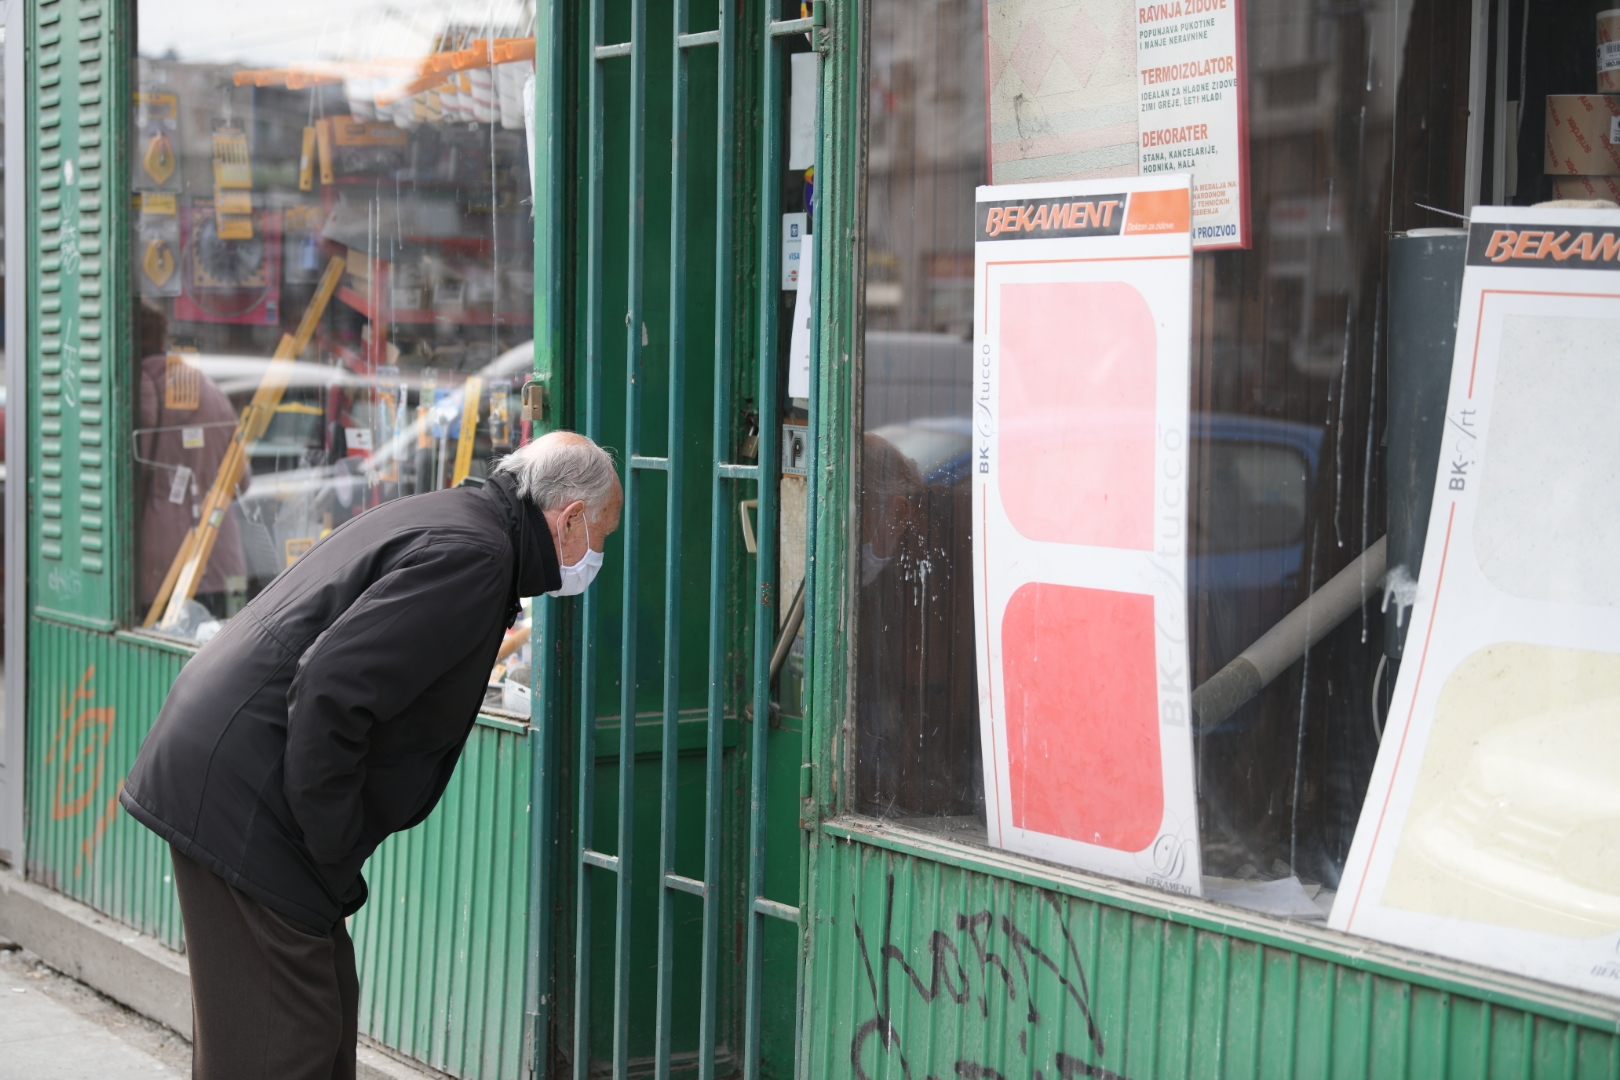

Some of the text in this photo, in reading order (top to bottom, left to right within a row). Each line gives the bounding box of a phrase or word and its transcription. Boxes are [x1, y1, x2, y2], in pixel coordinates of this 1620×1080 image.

[1139, 0, 1227, 24] RAVNJA ZIDOVE
[1139, 18, 1215, 39] POPUNJAVA PUKOTINE
[1144, 38, 1167, 50] MANJE
[1168, 31, 1208, 45] NERAVNINE
[1141, 55, 1234, 86] TERMOIZOLATOR
[1141, 78, 1237, 101] IDEALAN ZA HLADNE ZIDOVE
[1141, 92, 1222, 112] ZIMI GREJE, LETI HLADI
[1142, 123, 1208, 148] DEKORATER
[1566, 116, 1592, 153] smirdex
[1142, 145, 1218, 163] STANA, KANCELARIJE,
[1143, 159, 1196, 174] HODNIKA, HALA
[1199, 182, 1226, 192] MEDALJA
[985, 200, 1119, 237] BEKAMENT
[1197, 224, 1237, 239] PROIZVOD
[789, 252, 800, 260] VISA
